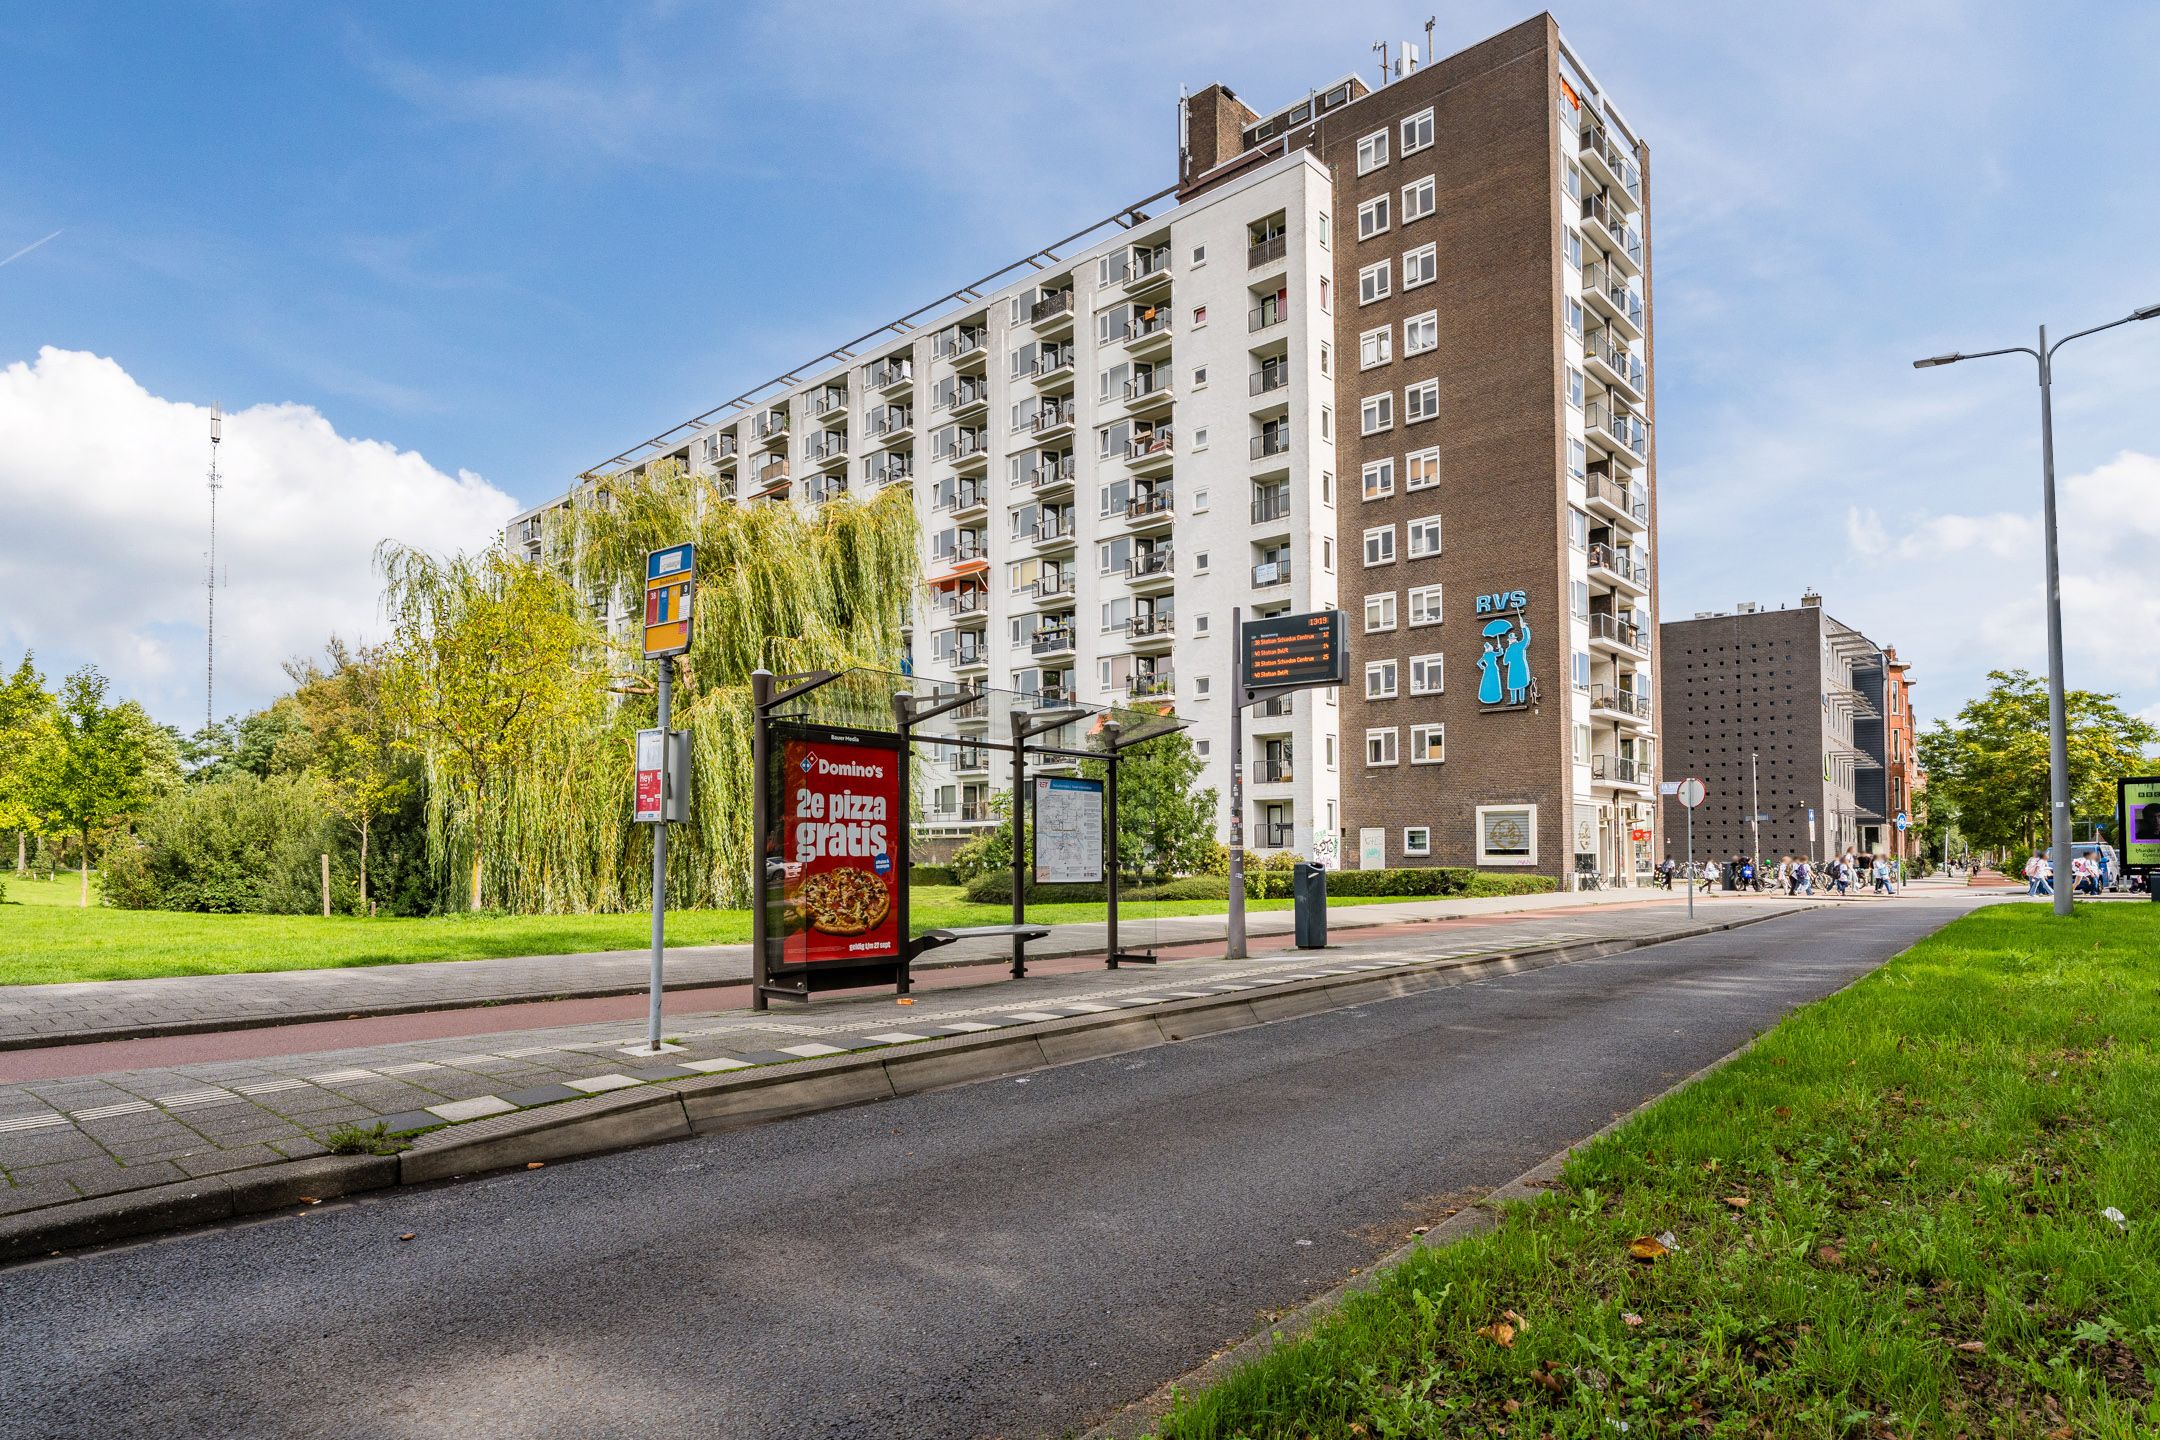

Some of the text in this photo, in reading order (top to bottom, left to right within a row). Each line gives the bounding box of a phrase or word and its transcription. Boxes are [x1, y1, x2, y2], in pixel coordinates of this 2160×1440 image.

[650, 591, 657, 600] 38
[1476, 590, 1527, 613] RVS
[639, 773, 653, 784] Hey!
[818, 758, 884, 779] Domino's
[796, 788, 887, 823] 2e pizza
[795, 820, 887, 863] gratis
[849, 943, 865, 951] geldig
